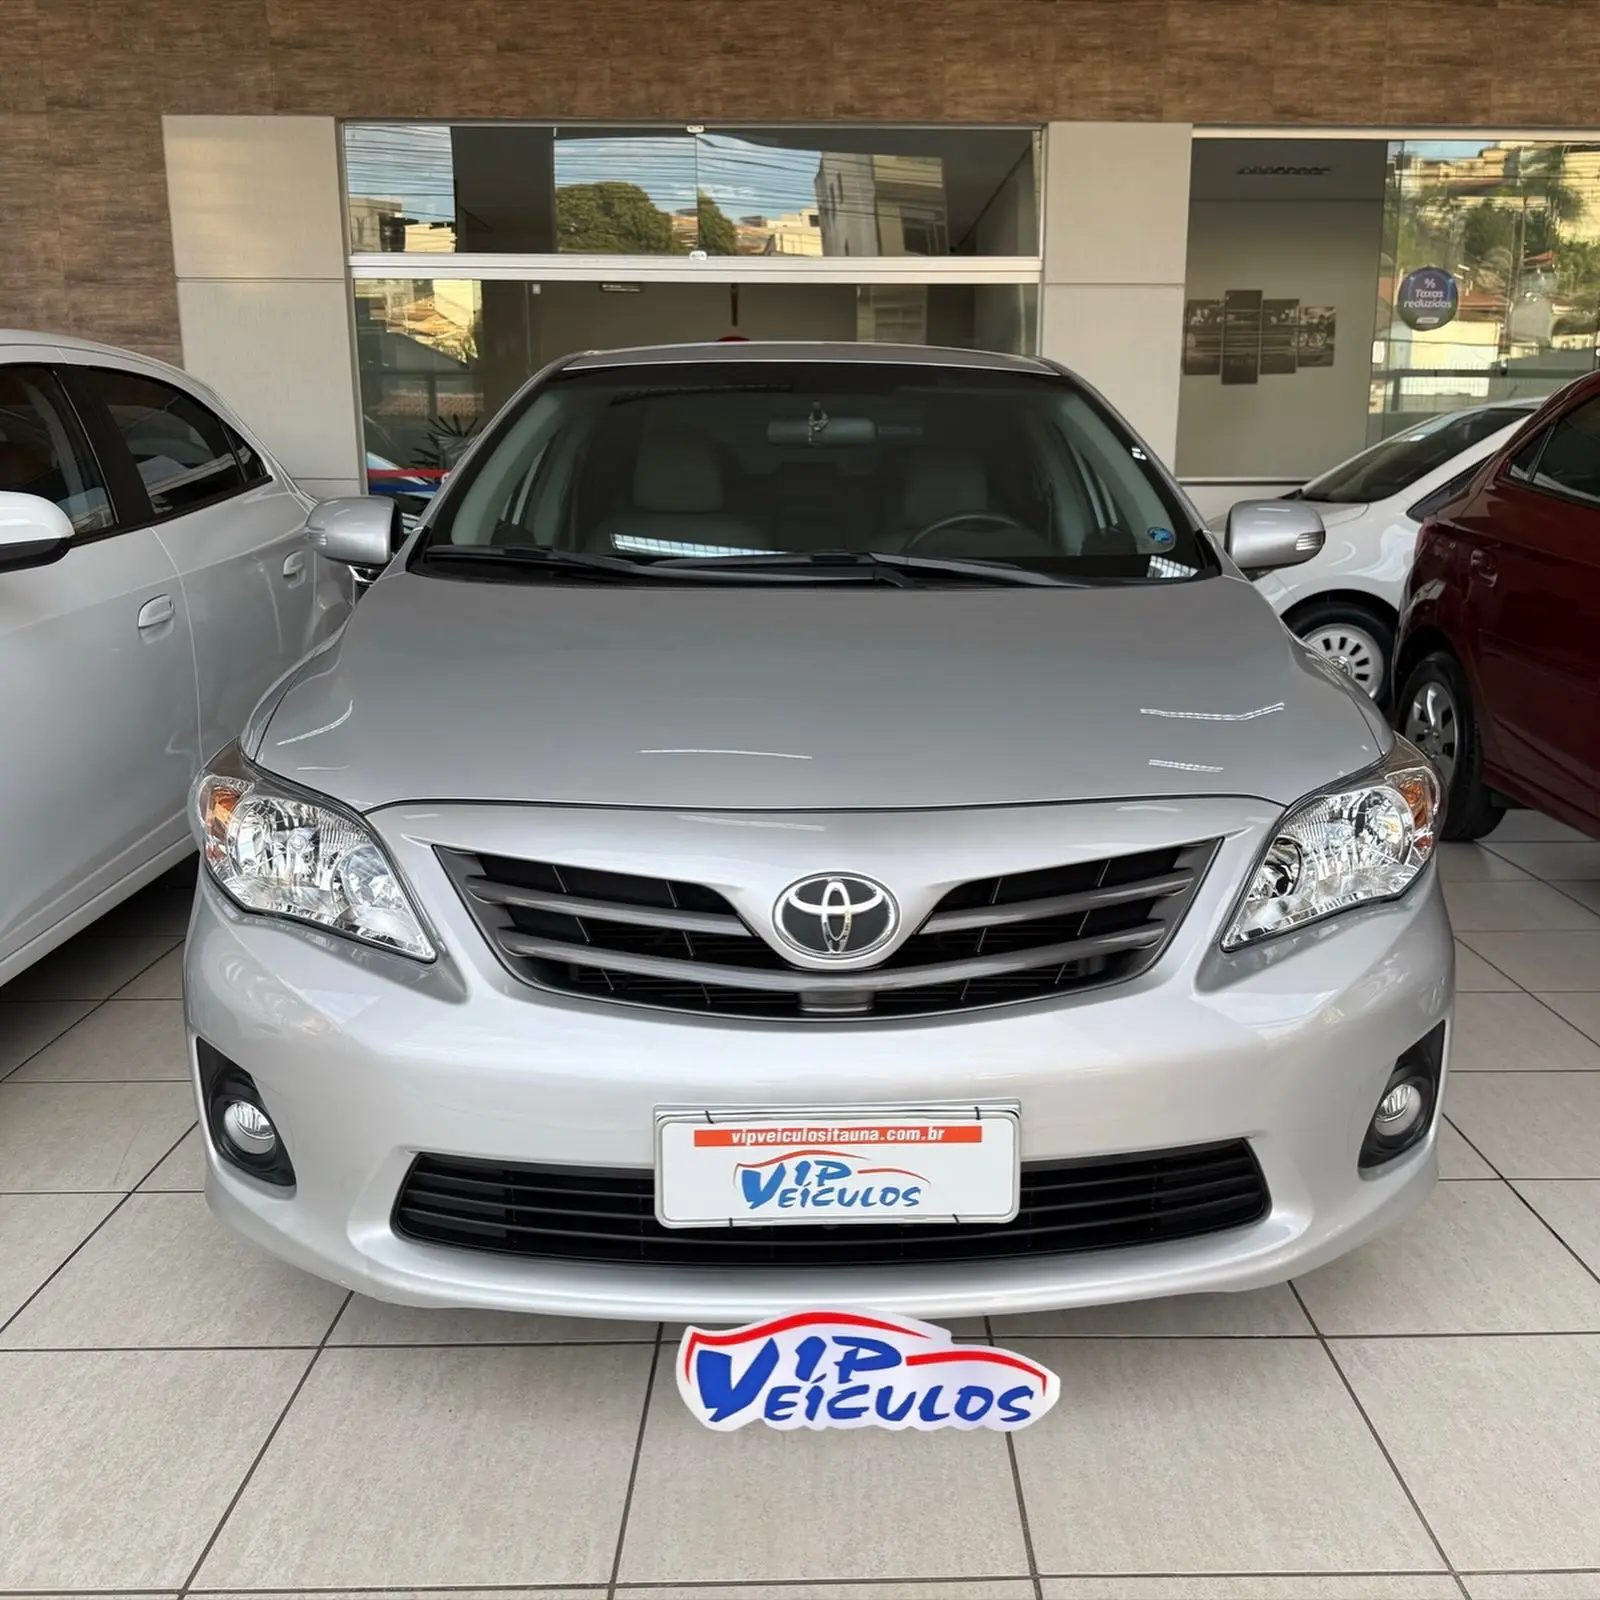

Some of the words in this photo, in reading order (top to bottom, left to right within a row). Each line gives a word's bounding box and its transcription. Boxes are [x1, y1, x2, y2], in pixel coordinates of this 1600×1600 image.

[1403, 299, 1452, 308] reduzidas
[1415, 289, 1443, 298] Taxas
[731, 1127, 945, 1147] vipveiculositauna.com.br
[741, 1160, 853, 1210] VIP
[696, 1335, 903, 1422] VIP
